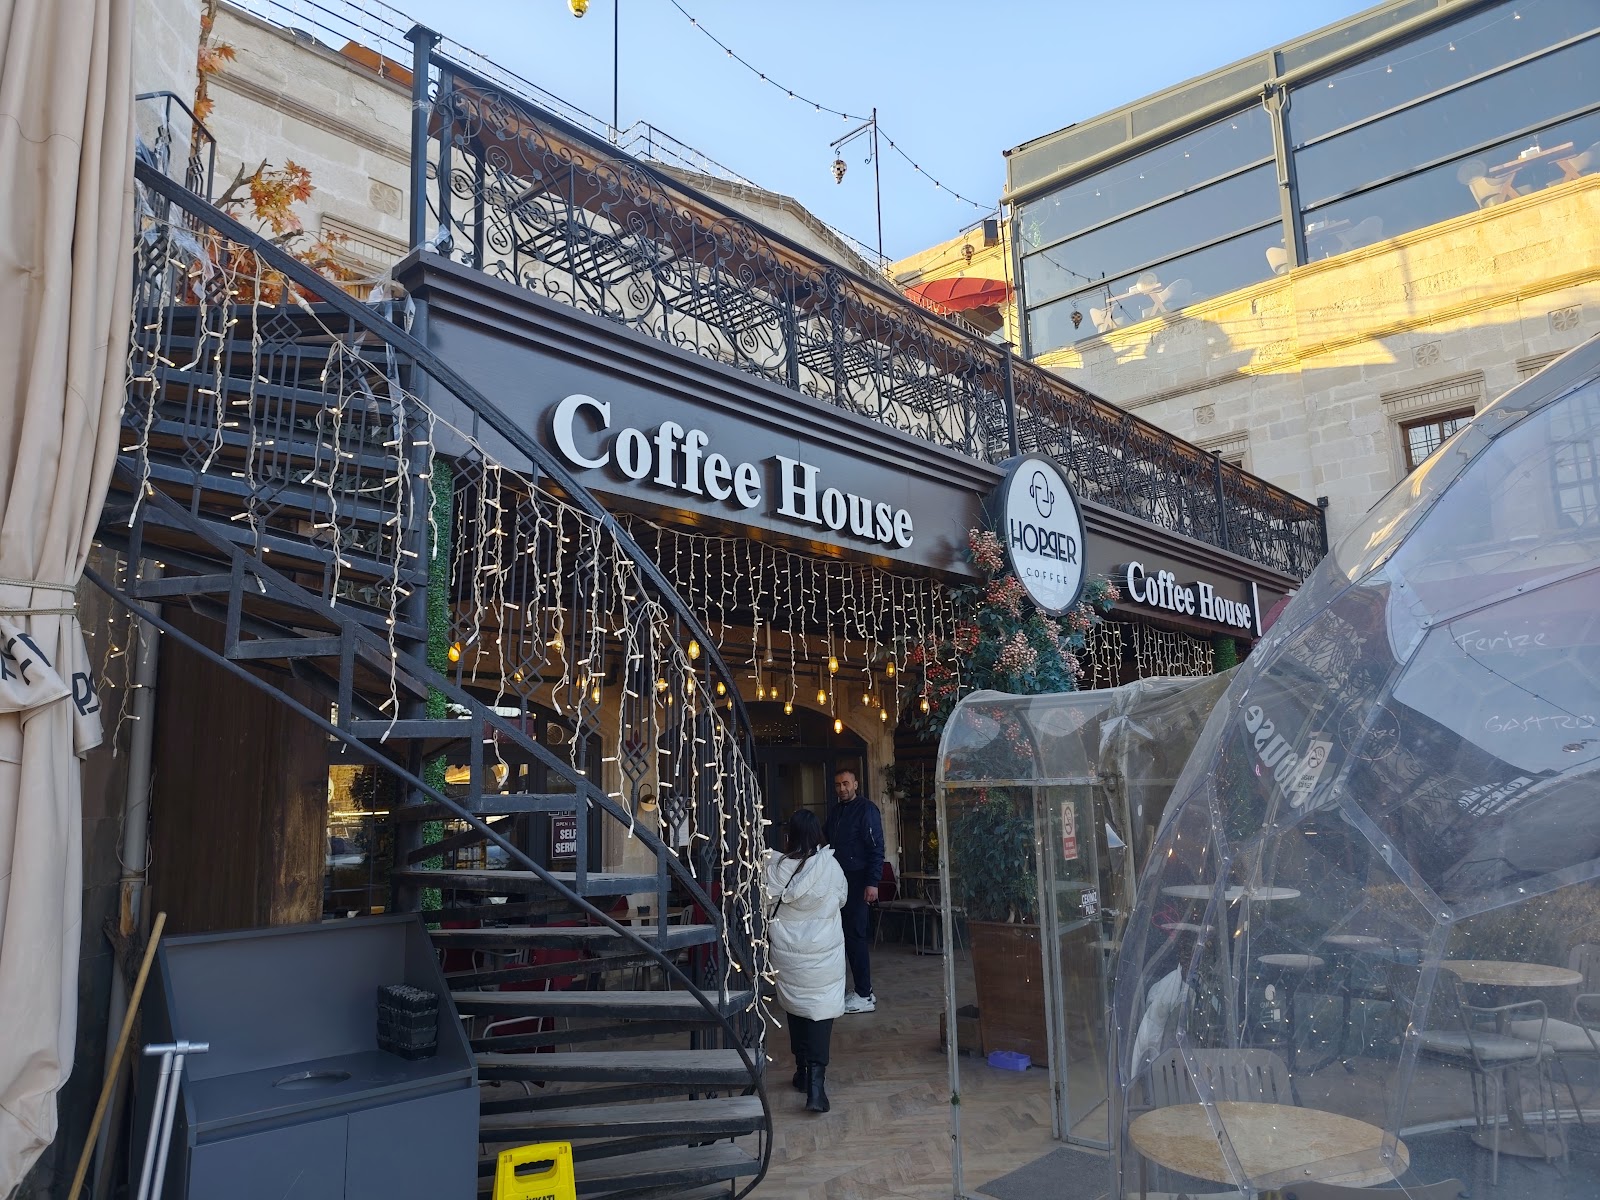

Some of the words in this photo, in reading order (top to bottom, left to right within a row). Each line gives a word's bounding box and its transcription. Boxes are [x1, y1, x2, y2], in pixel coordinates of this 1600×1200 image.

[553, 394, 761, 508] Coffee
[775, 455, 913, 548] House
[1026, 567, 1068, 585] COFFEE
[1127, 561, 1195, 615] Coffee
[1196, 581, 1252, 629] House
[1455, 630, 1547, 651] Ferize
